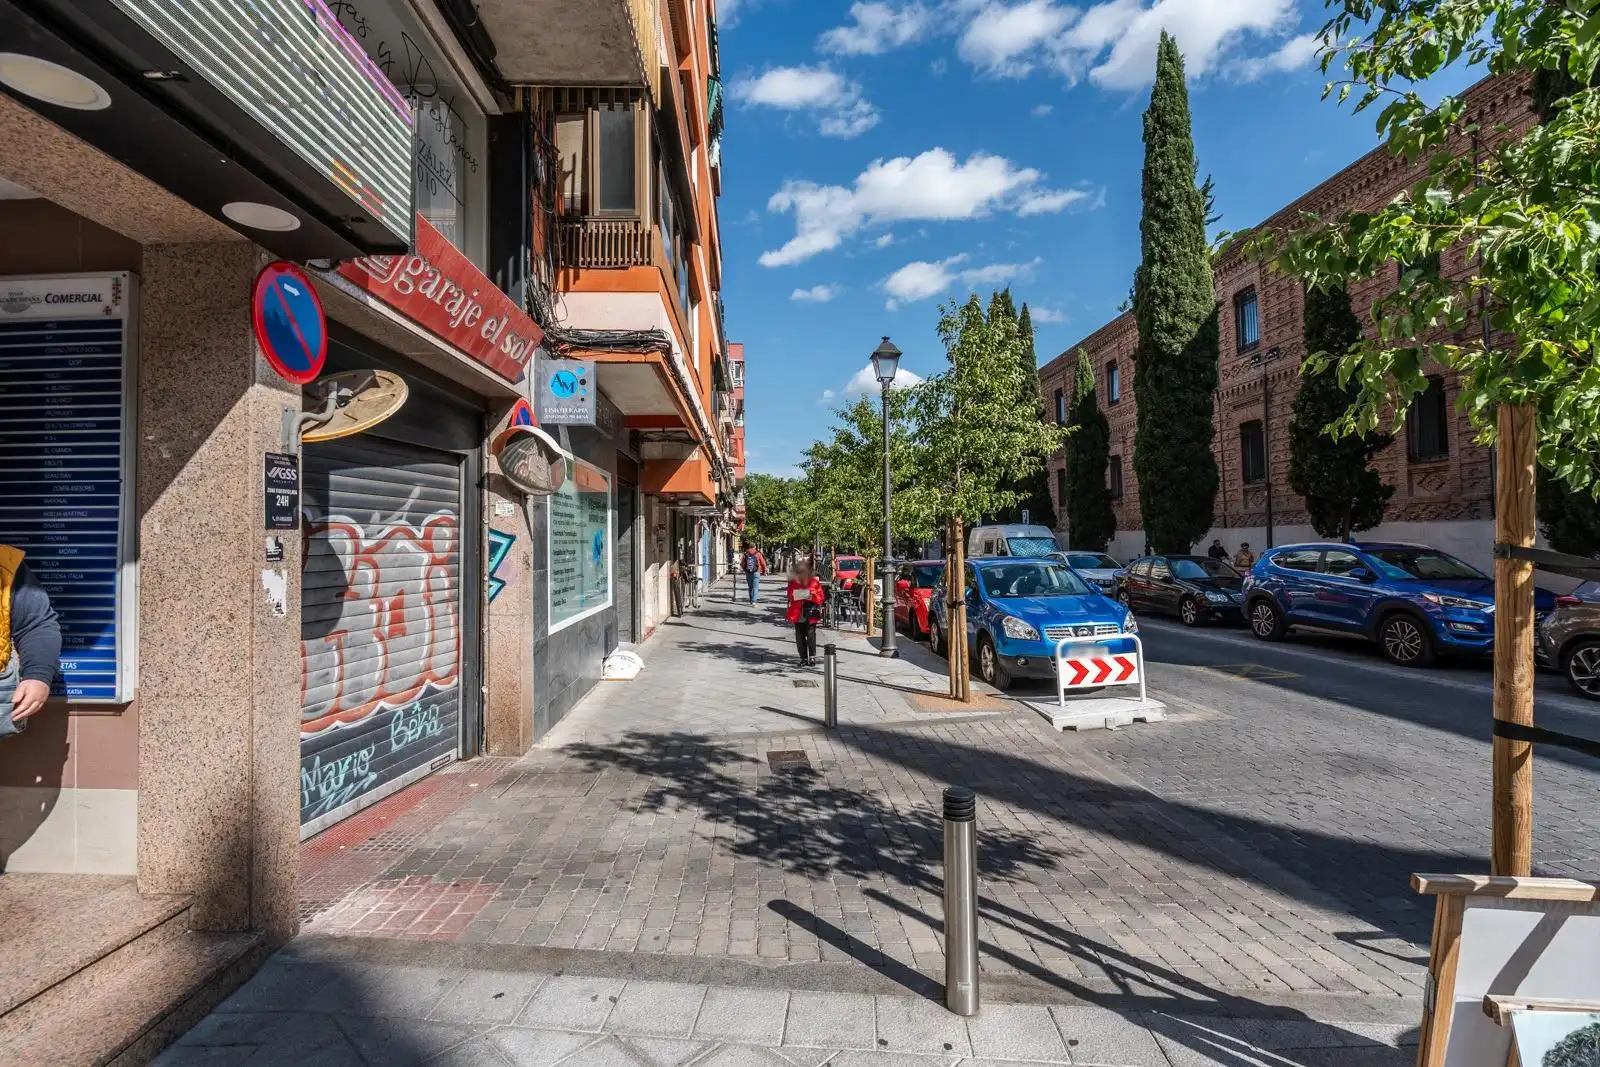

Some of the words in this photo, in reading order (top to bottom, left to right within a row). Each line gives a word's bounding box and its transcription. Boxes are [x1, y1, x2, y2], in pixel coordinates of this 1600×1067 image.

[417, 138, 452, 188] ZÁLEZ
[393, 255, 483, 329] garaje
[481, 315, 509, 345] el
[500, 331, 534, 365] sol
[278, 467, 297, 481] GSS
[276, 494, 289, 507] 24H
[60, 662, 78, 670] ETAS
[301, 741, 375, 806] Mario
